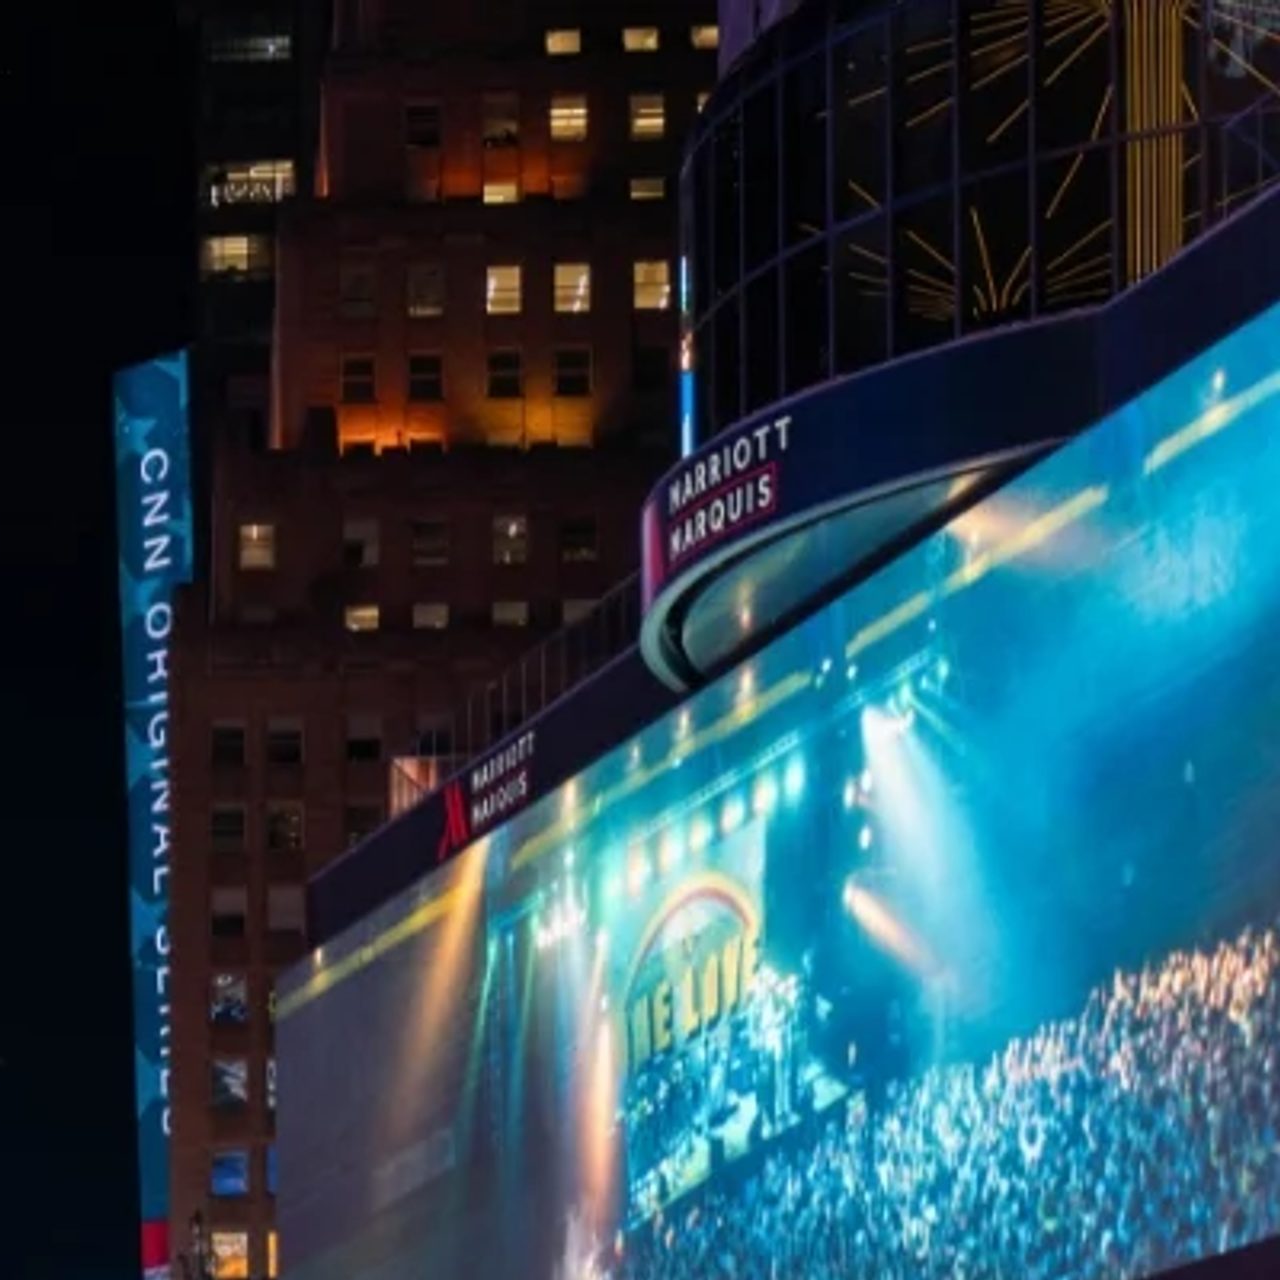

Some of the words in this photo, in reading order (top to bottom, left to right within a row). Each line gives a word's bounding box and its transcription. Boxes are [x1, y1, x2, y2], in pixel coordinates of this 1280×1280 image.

[668, 416, 792, 512] MARRIOTT
[140, 448, 171, 571] CNN
[669, 473, 774, 558] MARQUIS
[470, 730, 535, 790] MARRIOTT
[470, 772, 528, 824] MARQUIS
